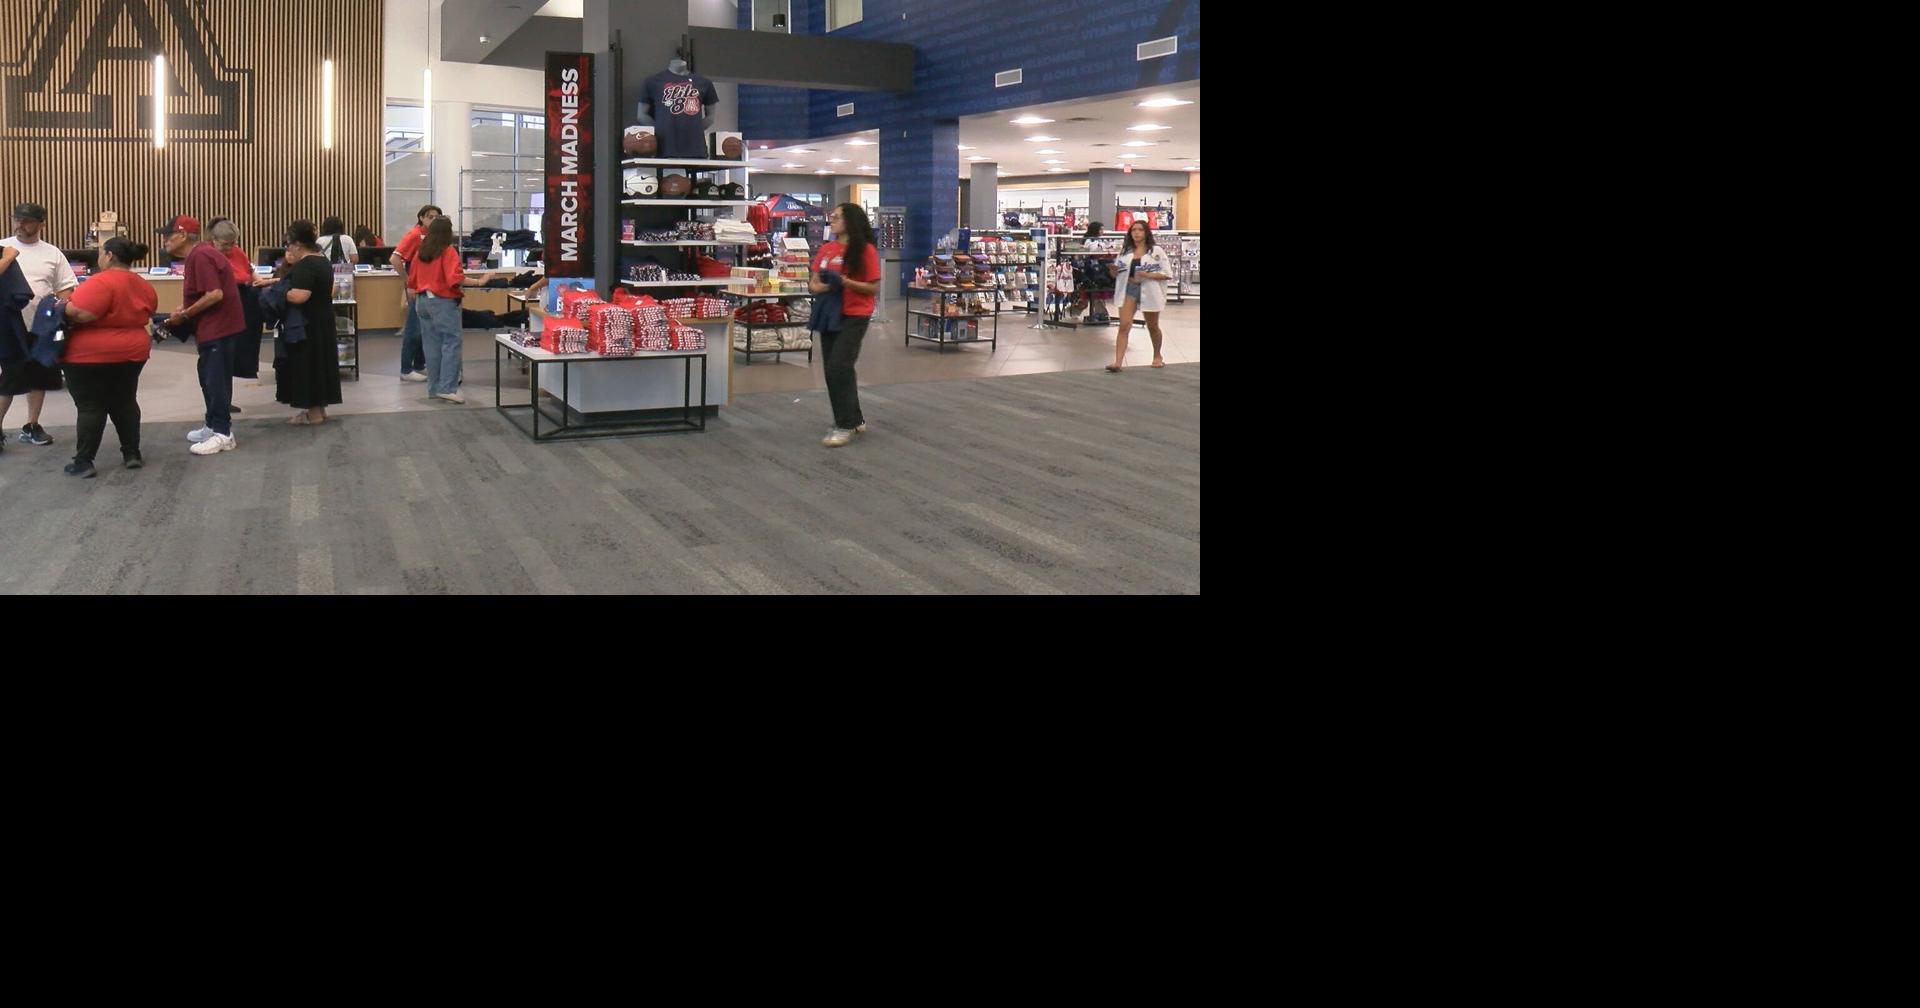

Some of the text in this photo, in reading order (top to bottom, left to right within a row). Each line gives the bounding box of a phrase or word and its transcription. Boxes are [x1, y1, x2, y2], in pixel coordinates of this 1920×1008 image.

[662, 84, 699, 103] Elite
[670, 97, 686, 114] 8
[561, 68, 579, 261] MARCH MADNESS
